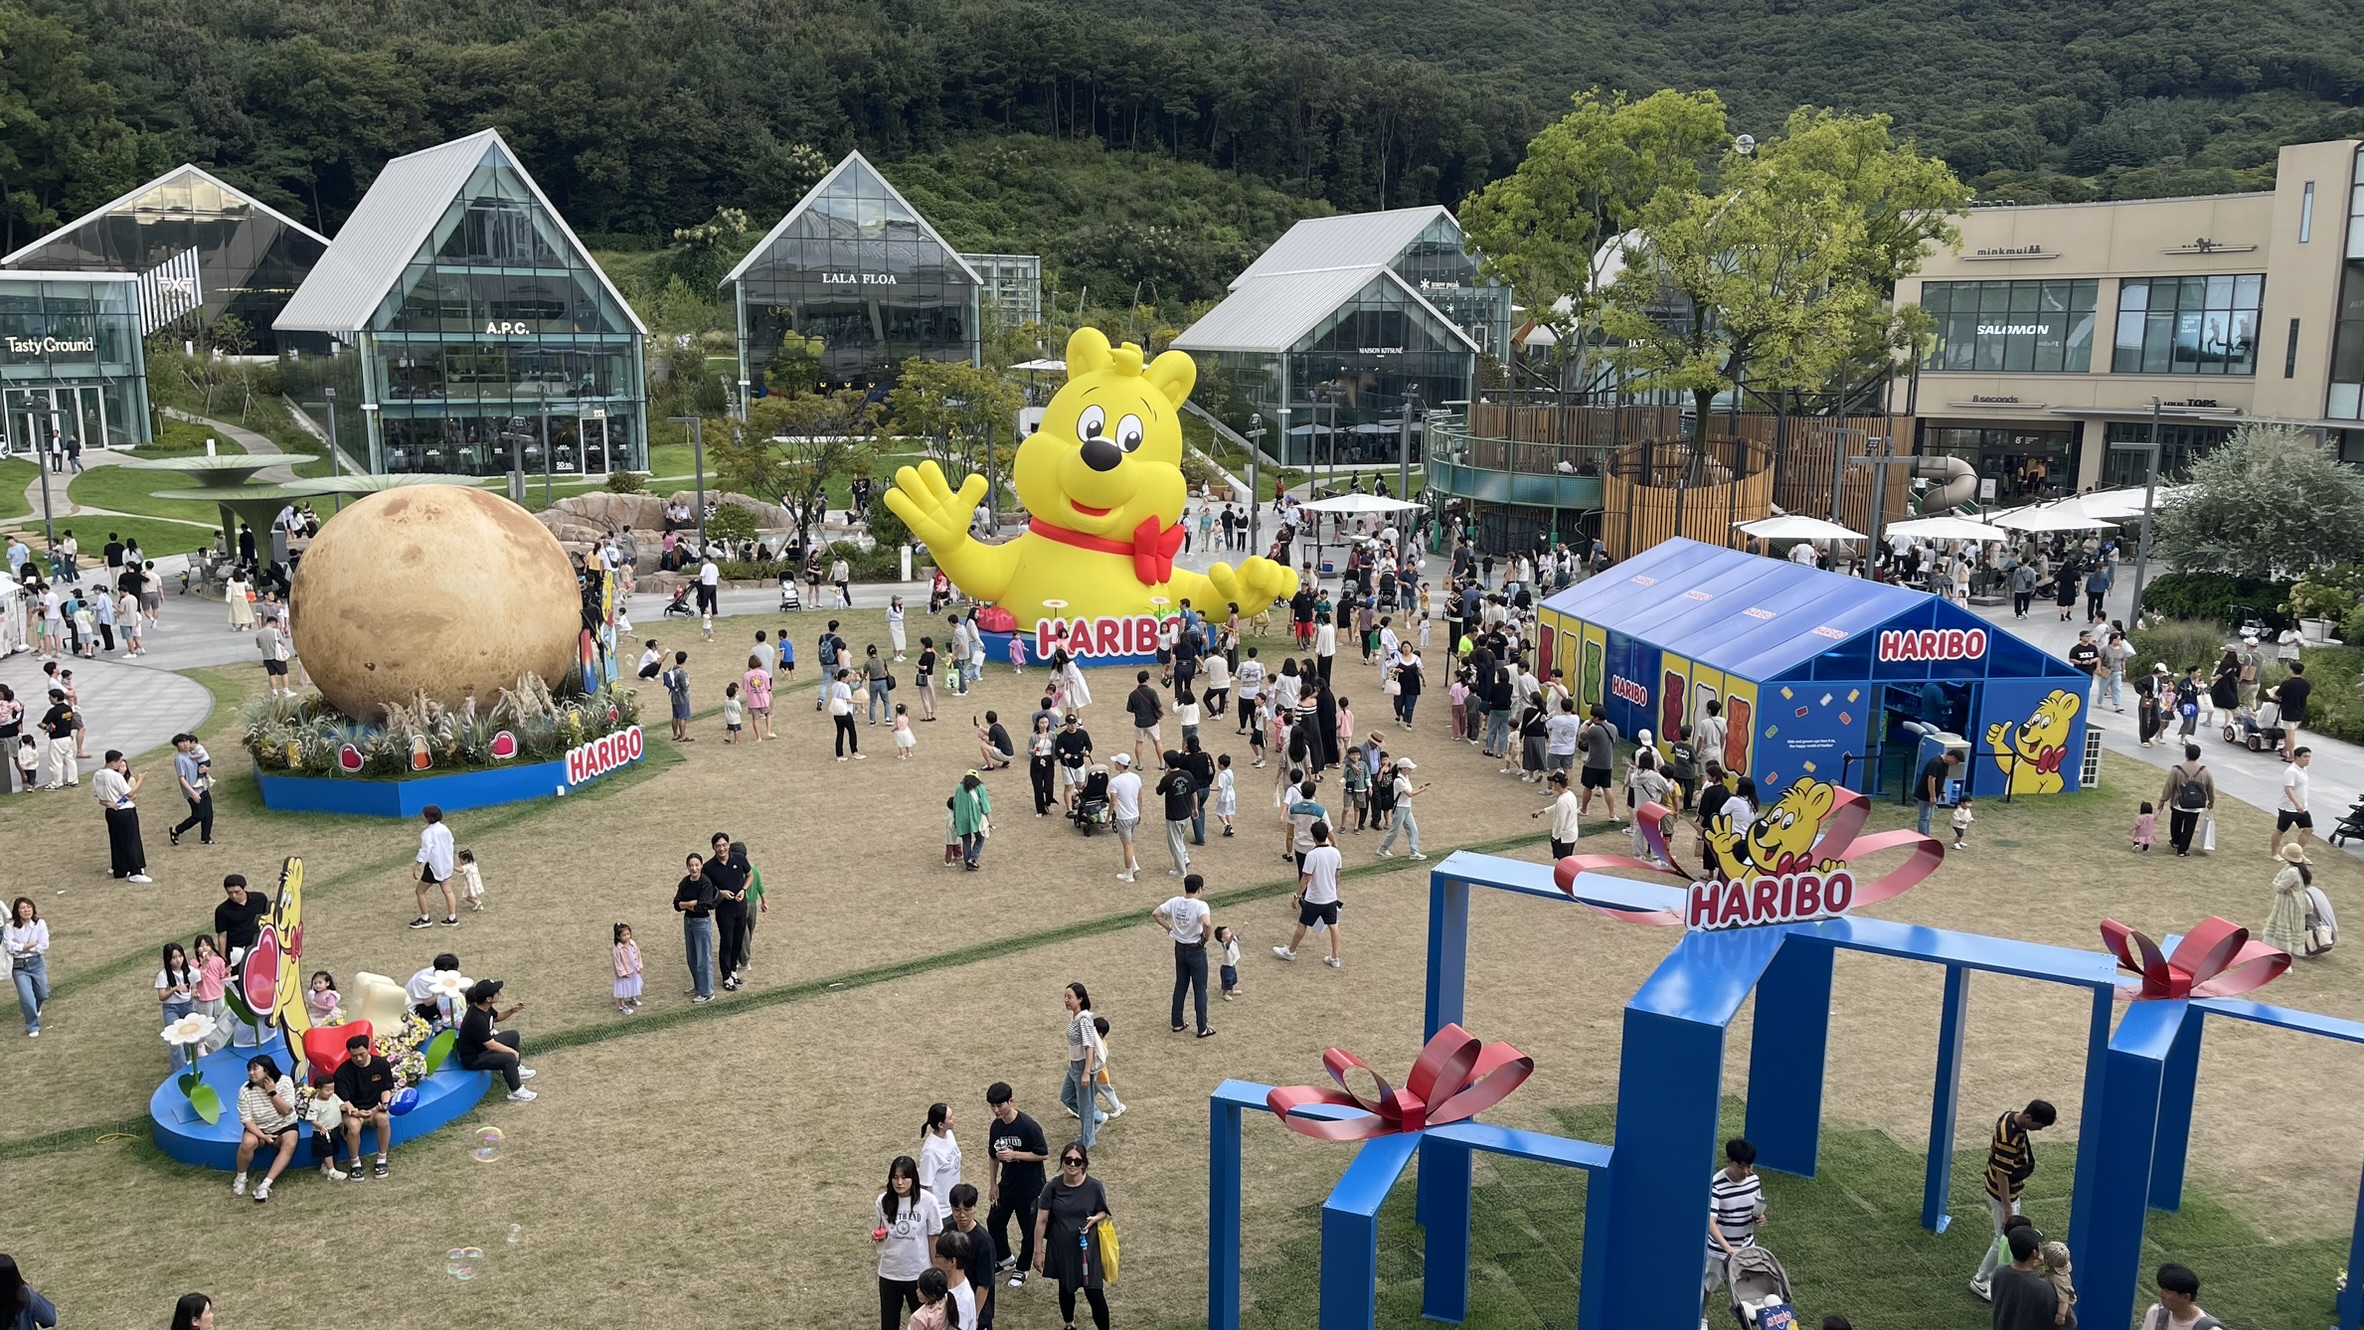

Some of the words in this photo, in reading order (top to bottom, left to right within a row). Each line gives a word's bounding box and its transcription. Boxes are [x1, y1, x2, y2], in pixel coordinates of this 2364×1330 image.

[822, 273, 858, 284] LALA
[862, 274, 897, 284] FLOA
[1446, 280, 1460, 290] peak
[486, 321, 530, 335] A.P.C.
[1977, 324, 2050, 335] SALOMON
[5, 337, 42, 355] Tasty
[43, 337, 94, 352] Ground
[1972, 394, 1980, 403] 8
[1980, 395, 2019, 404] seconds
[2186, 398, 2217, 408] TOPS
[1880, 631, 1985, 660] HARIBO
[1612, 675, 1647, 706] HARIBO
[569, 728, 642, 783] HARIBO
[1690, 873, 1853, 927] HARIBO
